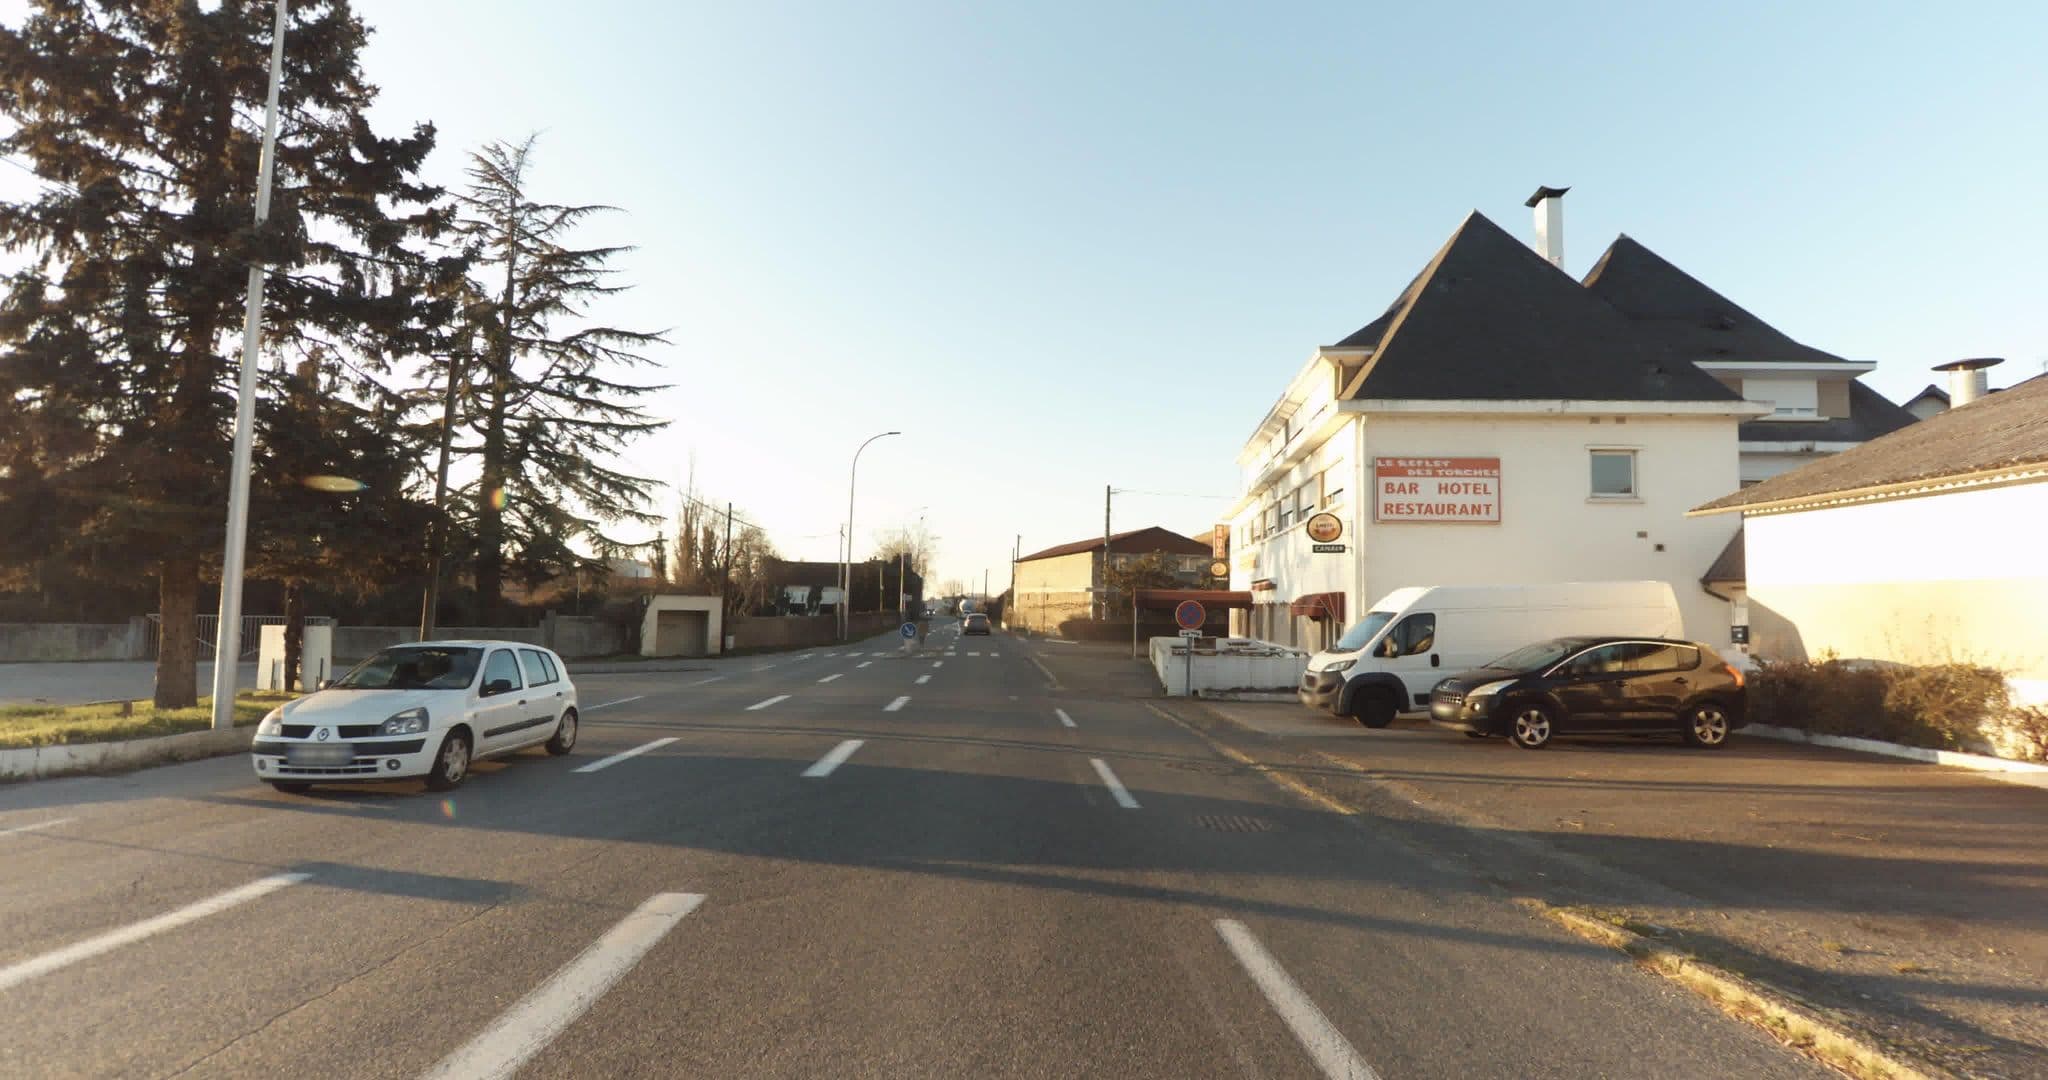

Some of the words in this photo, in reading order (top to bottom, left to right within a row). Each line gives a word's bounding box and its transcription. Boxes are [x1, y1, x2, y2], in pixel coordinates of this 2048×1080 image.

[1376, 459, 1393, 467] LE
[1407, 468, 1433, 476] DES
[1437, 469, 1499, 477] TORCHES
[1384, 482, 1419, 495] BAR
[1438, 482, 1492, 495] HOTEL
[1383, 503, 1493, 516] RESTAURANT
